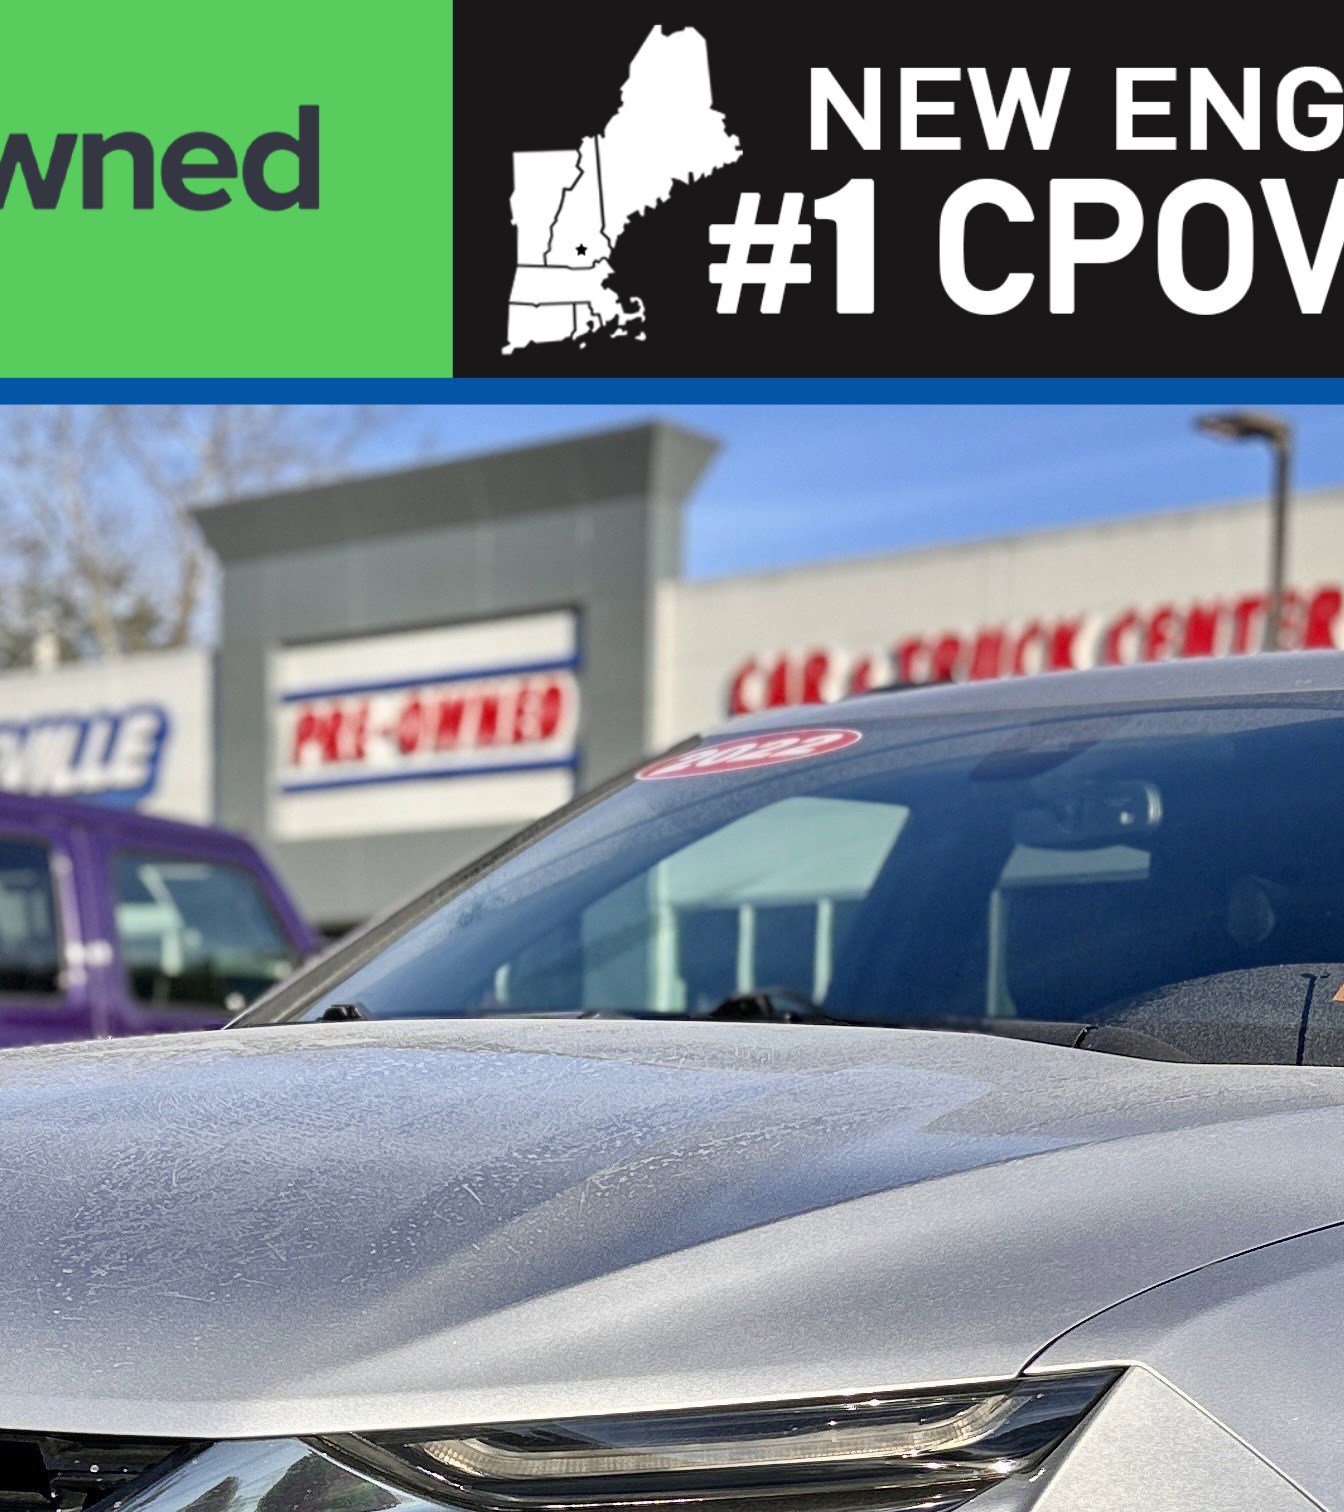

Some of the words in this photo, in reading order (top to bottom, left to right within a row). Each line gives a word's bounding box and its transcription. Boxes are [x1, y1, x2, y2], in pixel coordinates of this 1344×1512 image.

[728, 650, 836, 716] CAR
[290, 682, 562, 766] PRE-OWNED
[656, 732, 844, 774] 2022
